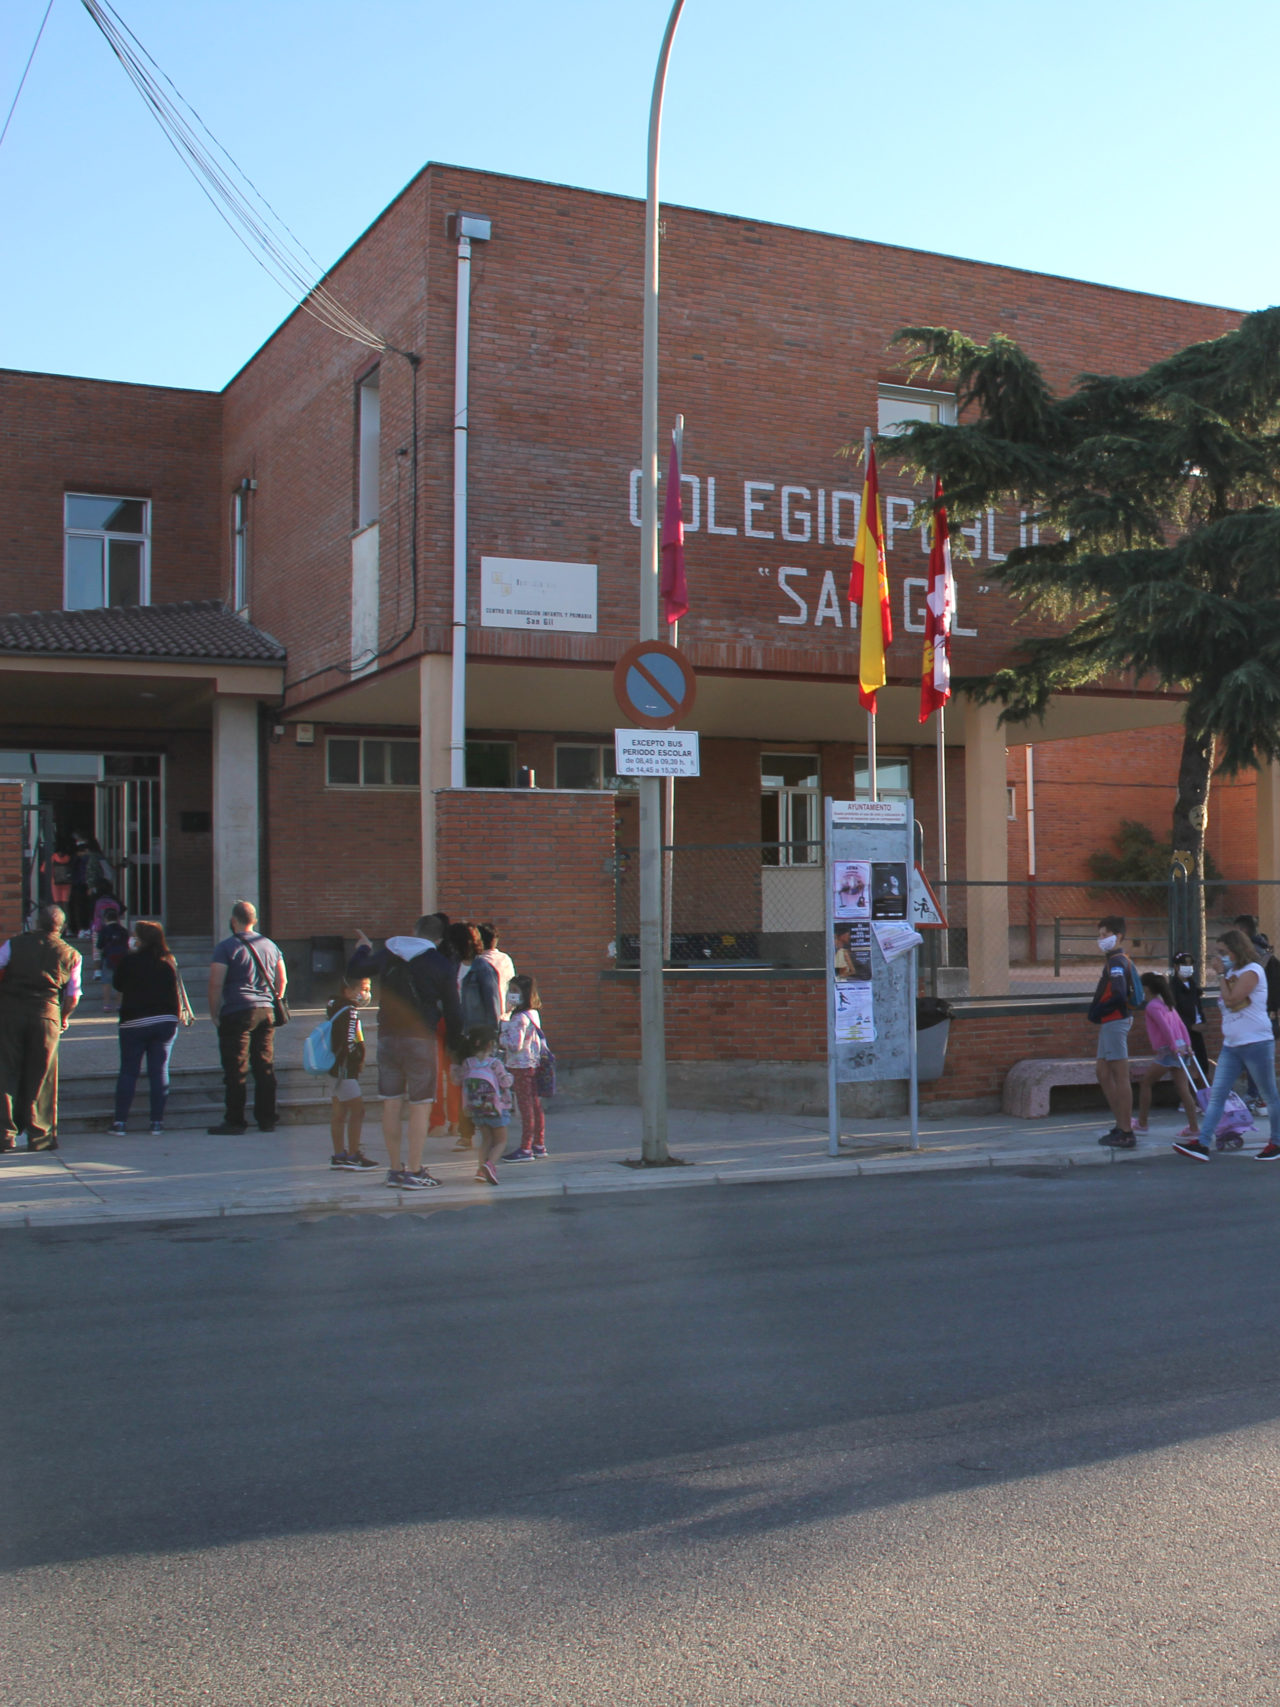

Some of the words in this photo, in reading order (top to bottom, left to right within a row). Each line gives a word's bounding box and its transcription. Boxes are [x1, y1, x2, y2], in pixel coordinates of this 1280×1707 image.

[526, 617, 540, 625] San
[632, 739, 665, 747] EXCEPTO
[623, 748, 656, 756] PERIODO
[657, 749, 693, 757] ESCOLAR
[847, 803, 892, 811] AYUNTAMIENTO
